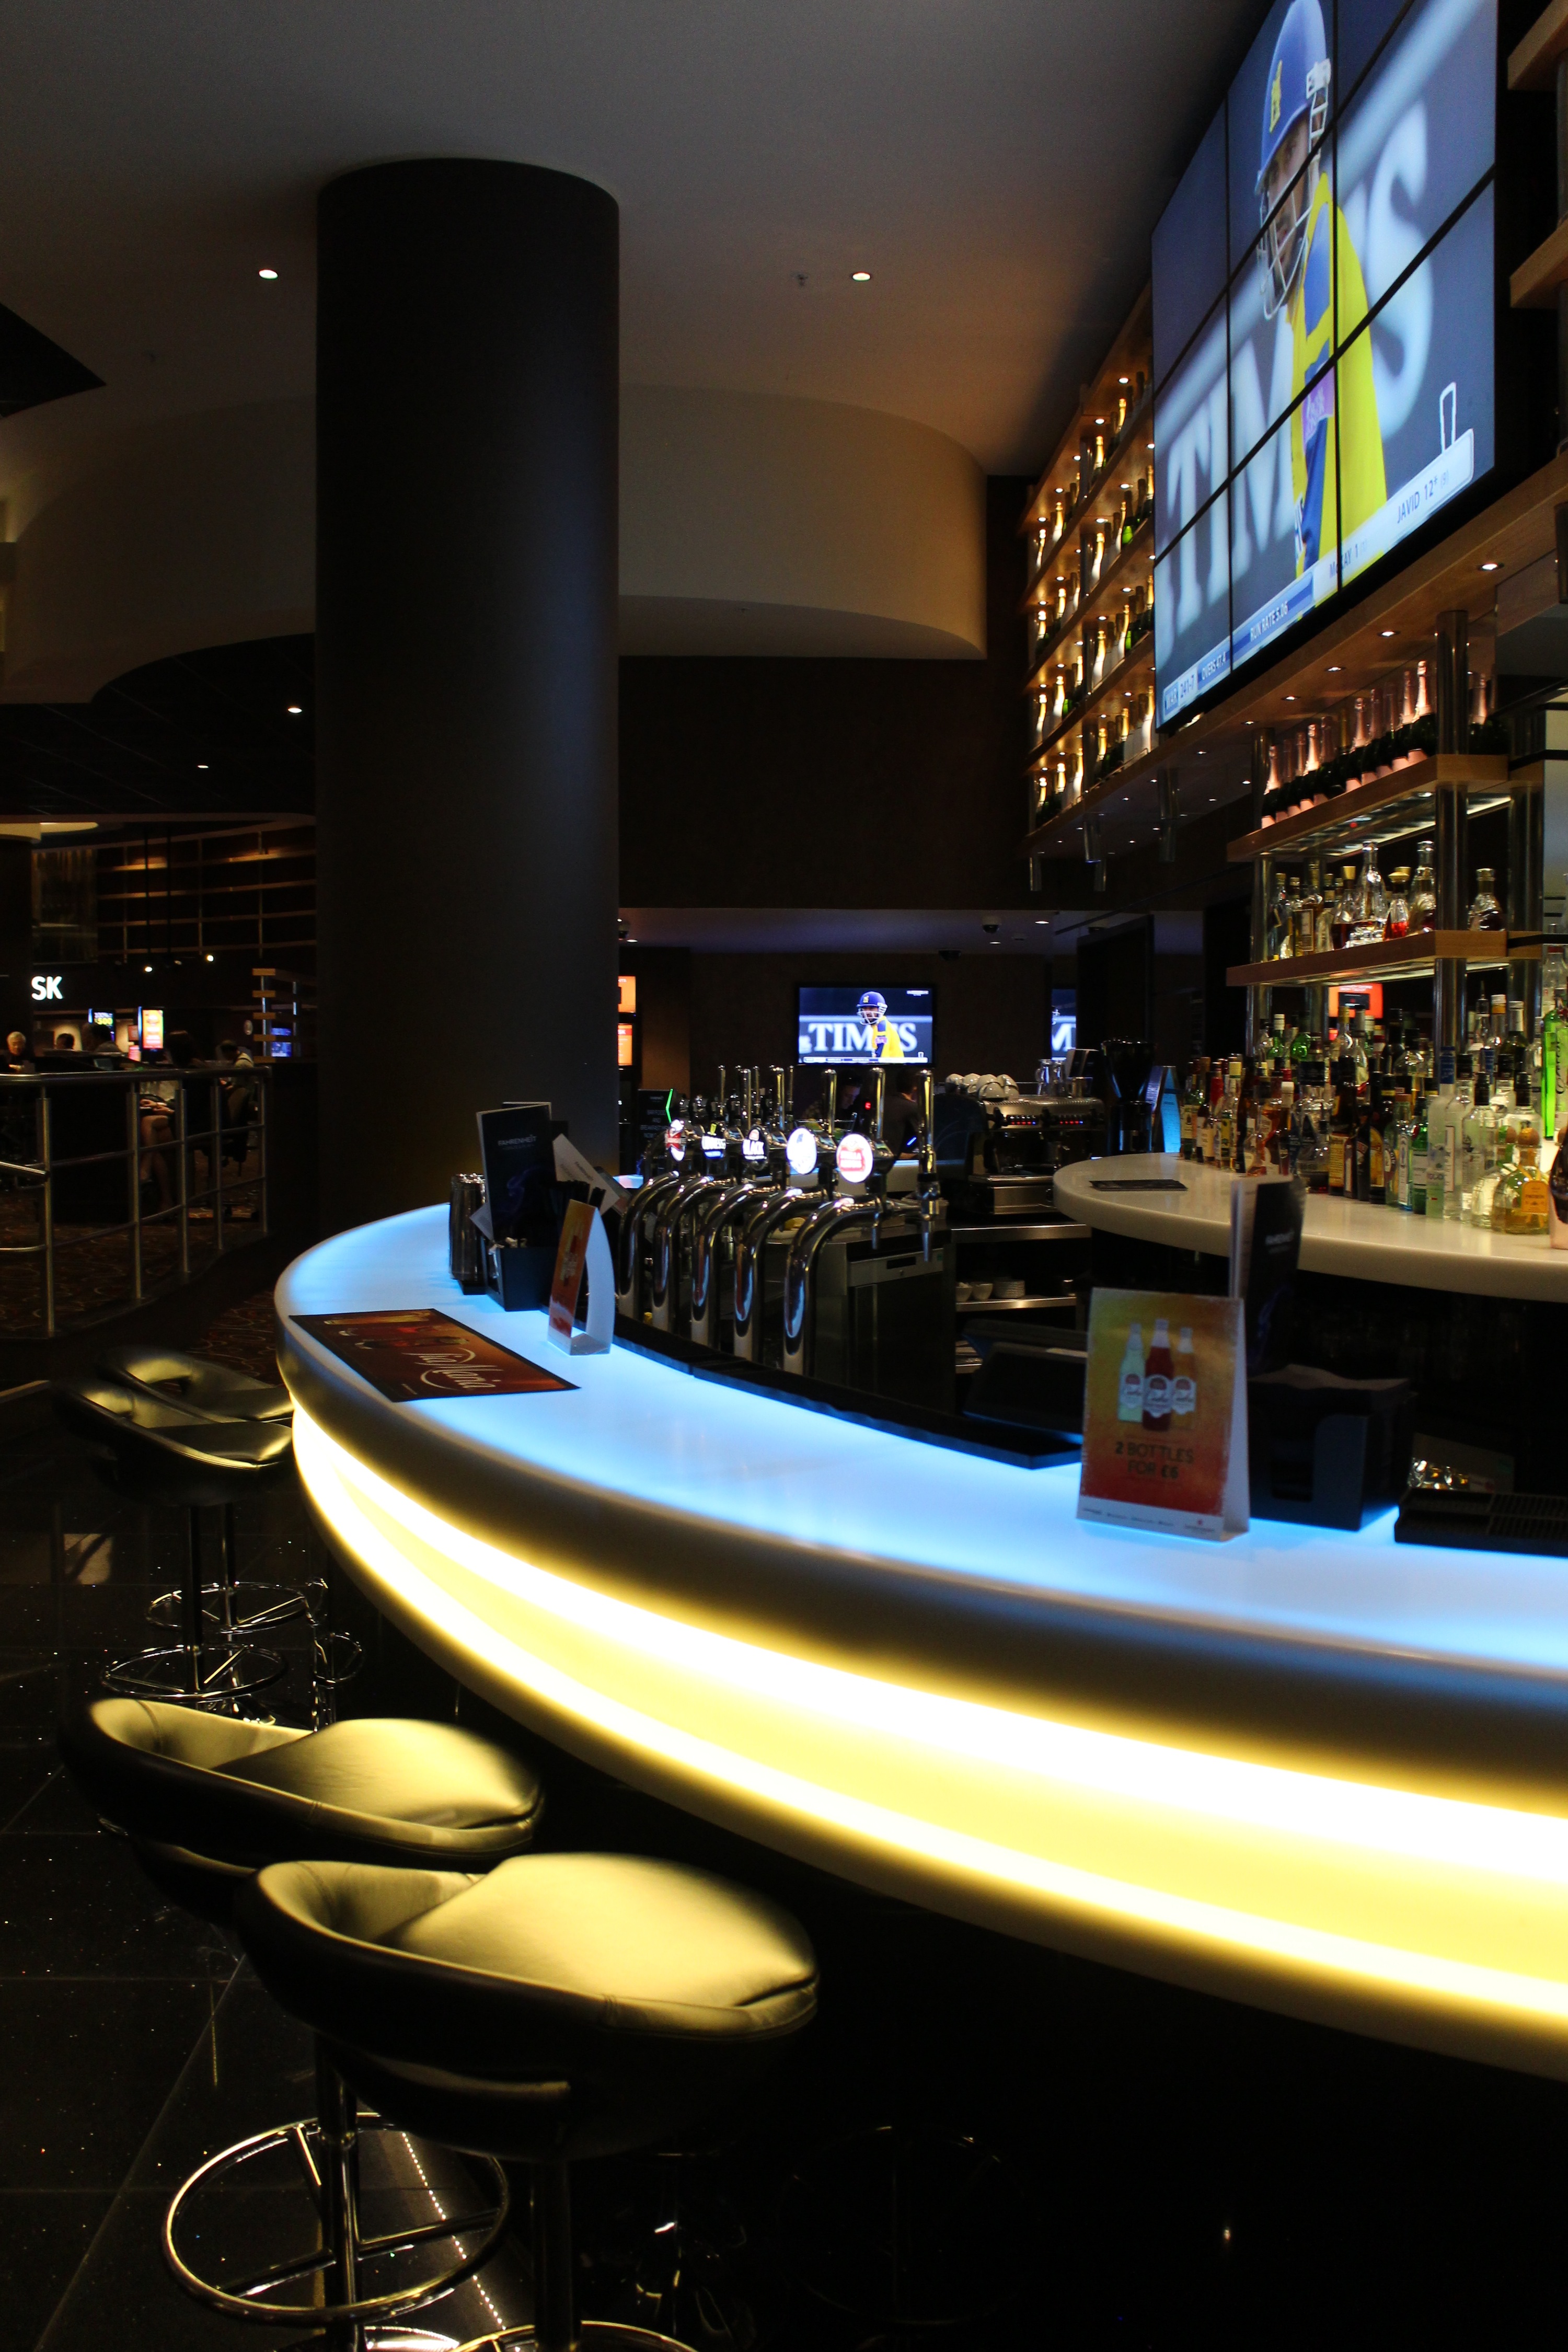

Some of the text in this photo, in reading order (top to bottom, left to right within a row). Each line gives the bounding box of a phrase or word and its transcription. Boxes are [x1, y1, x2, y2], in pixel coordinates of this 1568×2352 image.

[1201, 660, 1216, 681] OVERS
[1250, 622, 1262, 642] RUN
[1262, 610, 1276, 635] RATE
[1397, 491, 1420, 524] JAVID
[808, 1022, 918, 1053] TIMS
[1115, 1441, 1194, 1465] 2 BOTTLES
[1128, 1459, 1156, 1475] FOR
